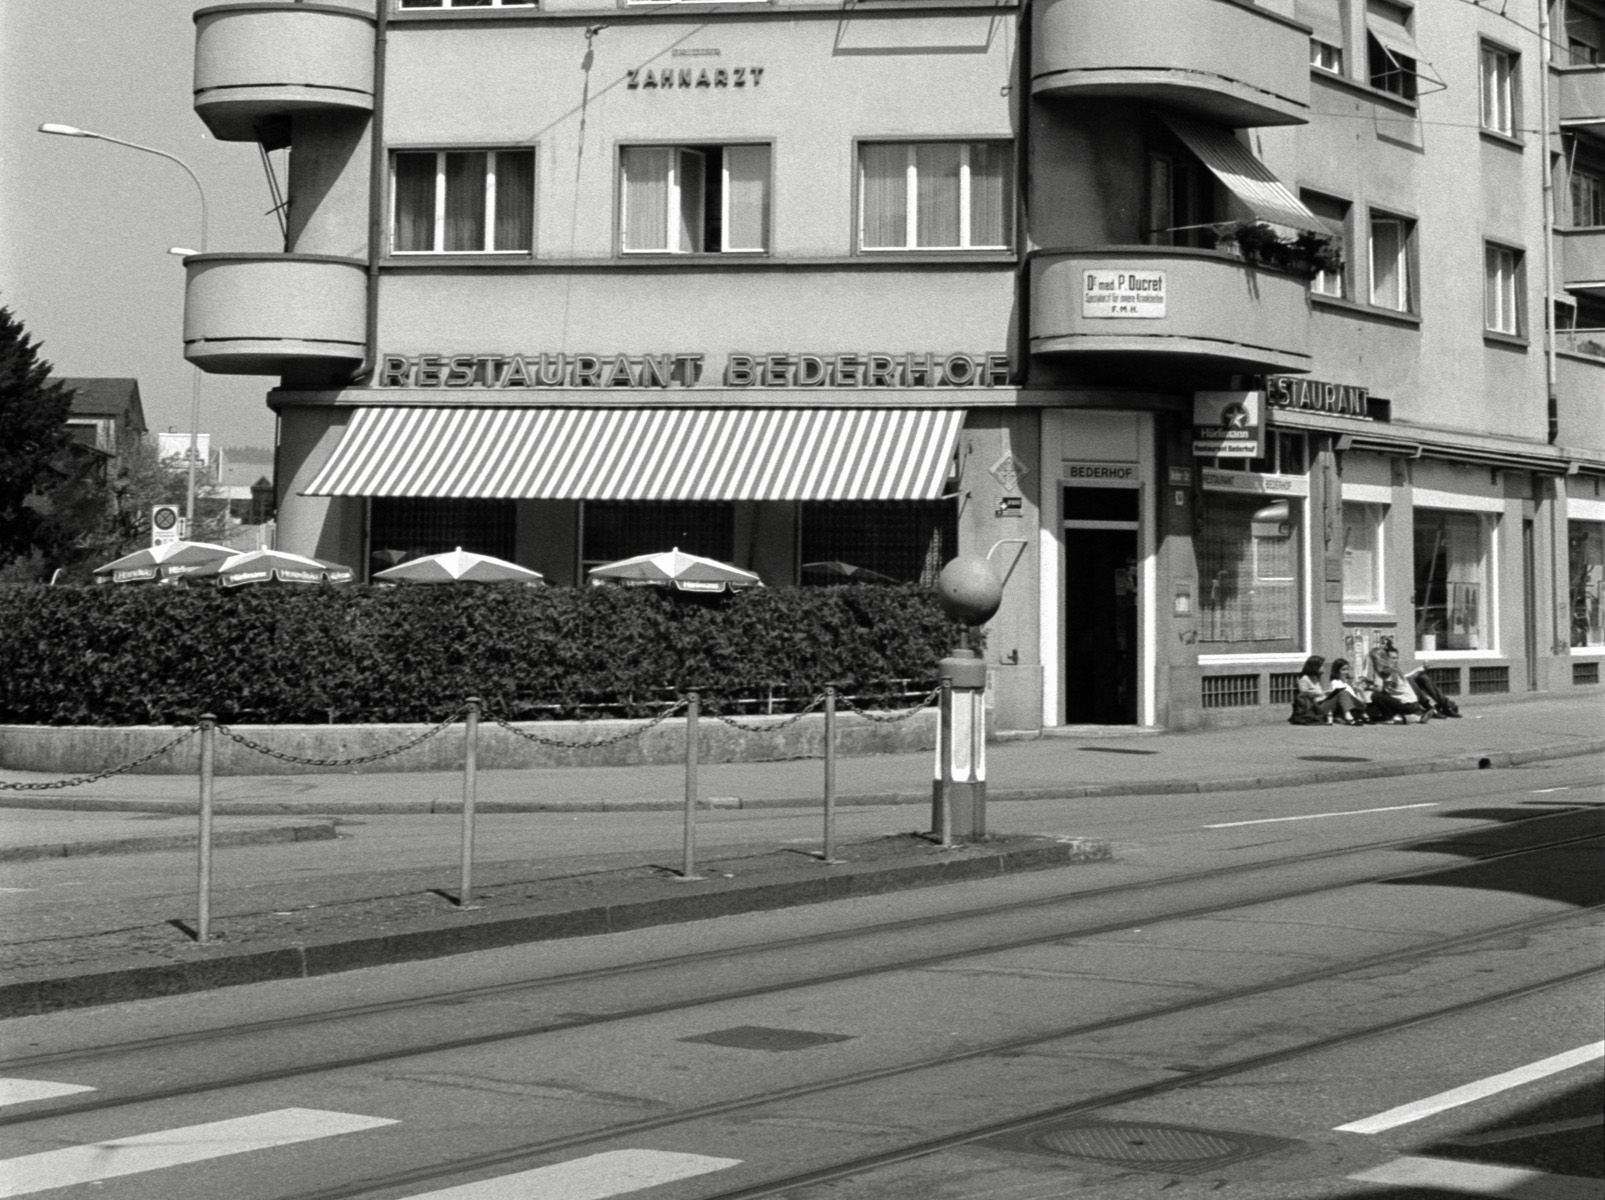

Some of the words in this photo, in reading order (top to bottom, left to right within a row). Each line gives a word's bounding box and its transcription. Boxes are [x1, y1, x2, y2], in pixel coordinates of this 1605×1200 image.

[626, 66, 764, 91] ZAHNARZT
[1129, 275, 1162, 291] Ducret
[380, 353, 704, 388] RESTAURANT
[727, 352, 1009, 388] BEDERHOF
[1265, 377, 1370, 416] ESTAURANT
[1070, 466, 1133, 479] BEDERHOF
